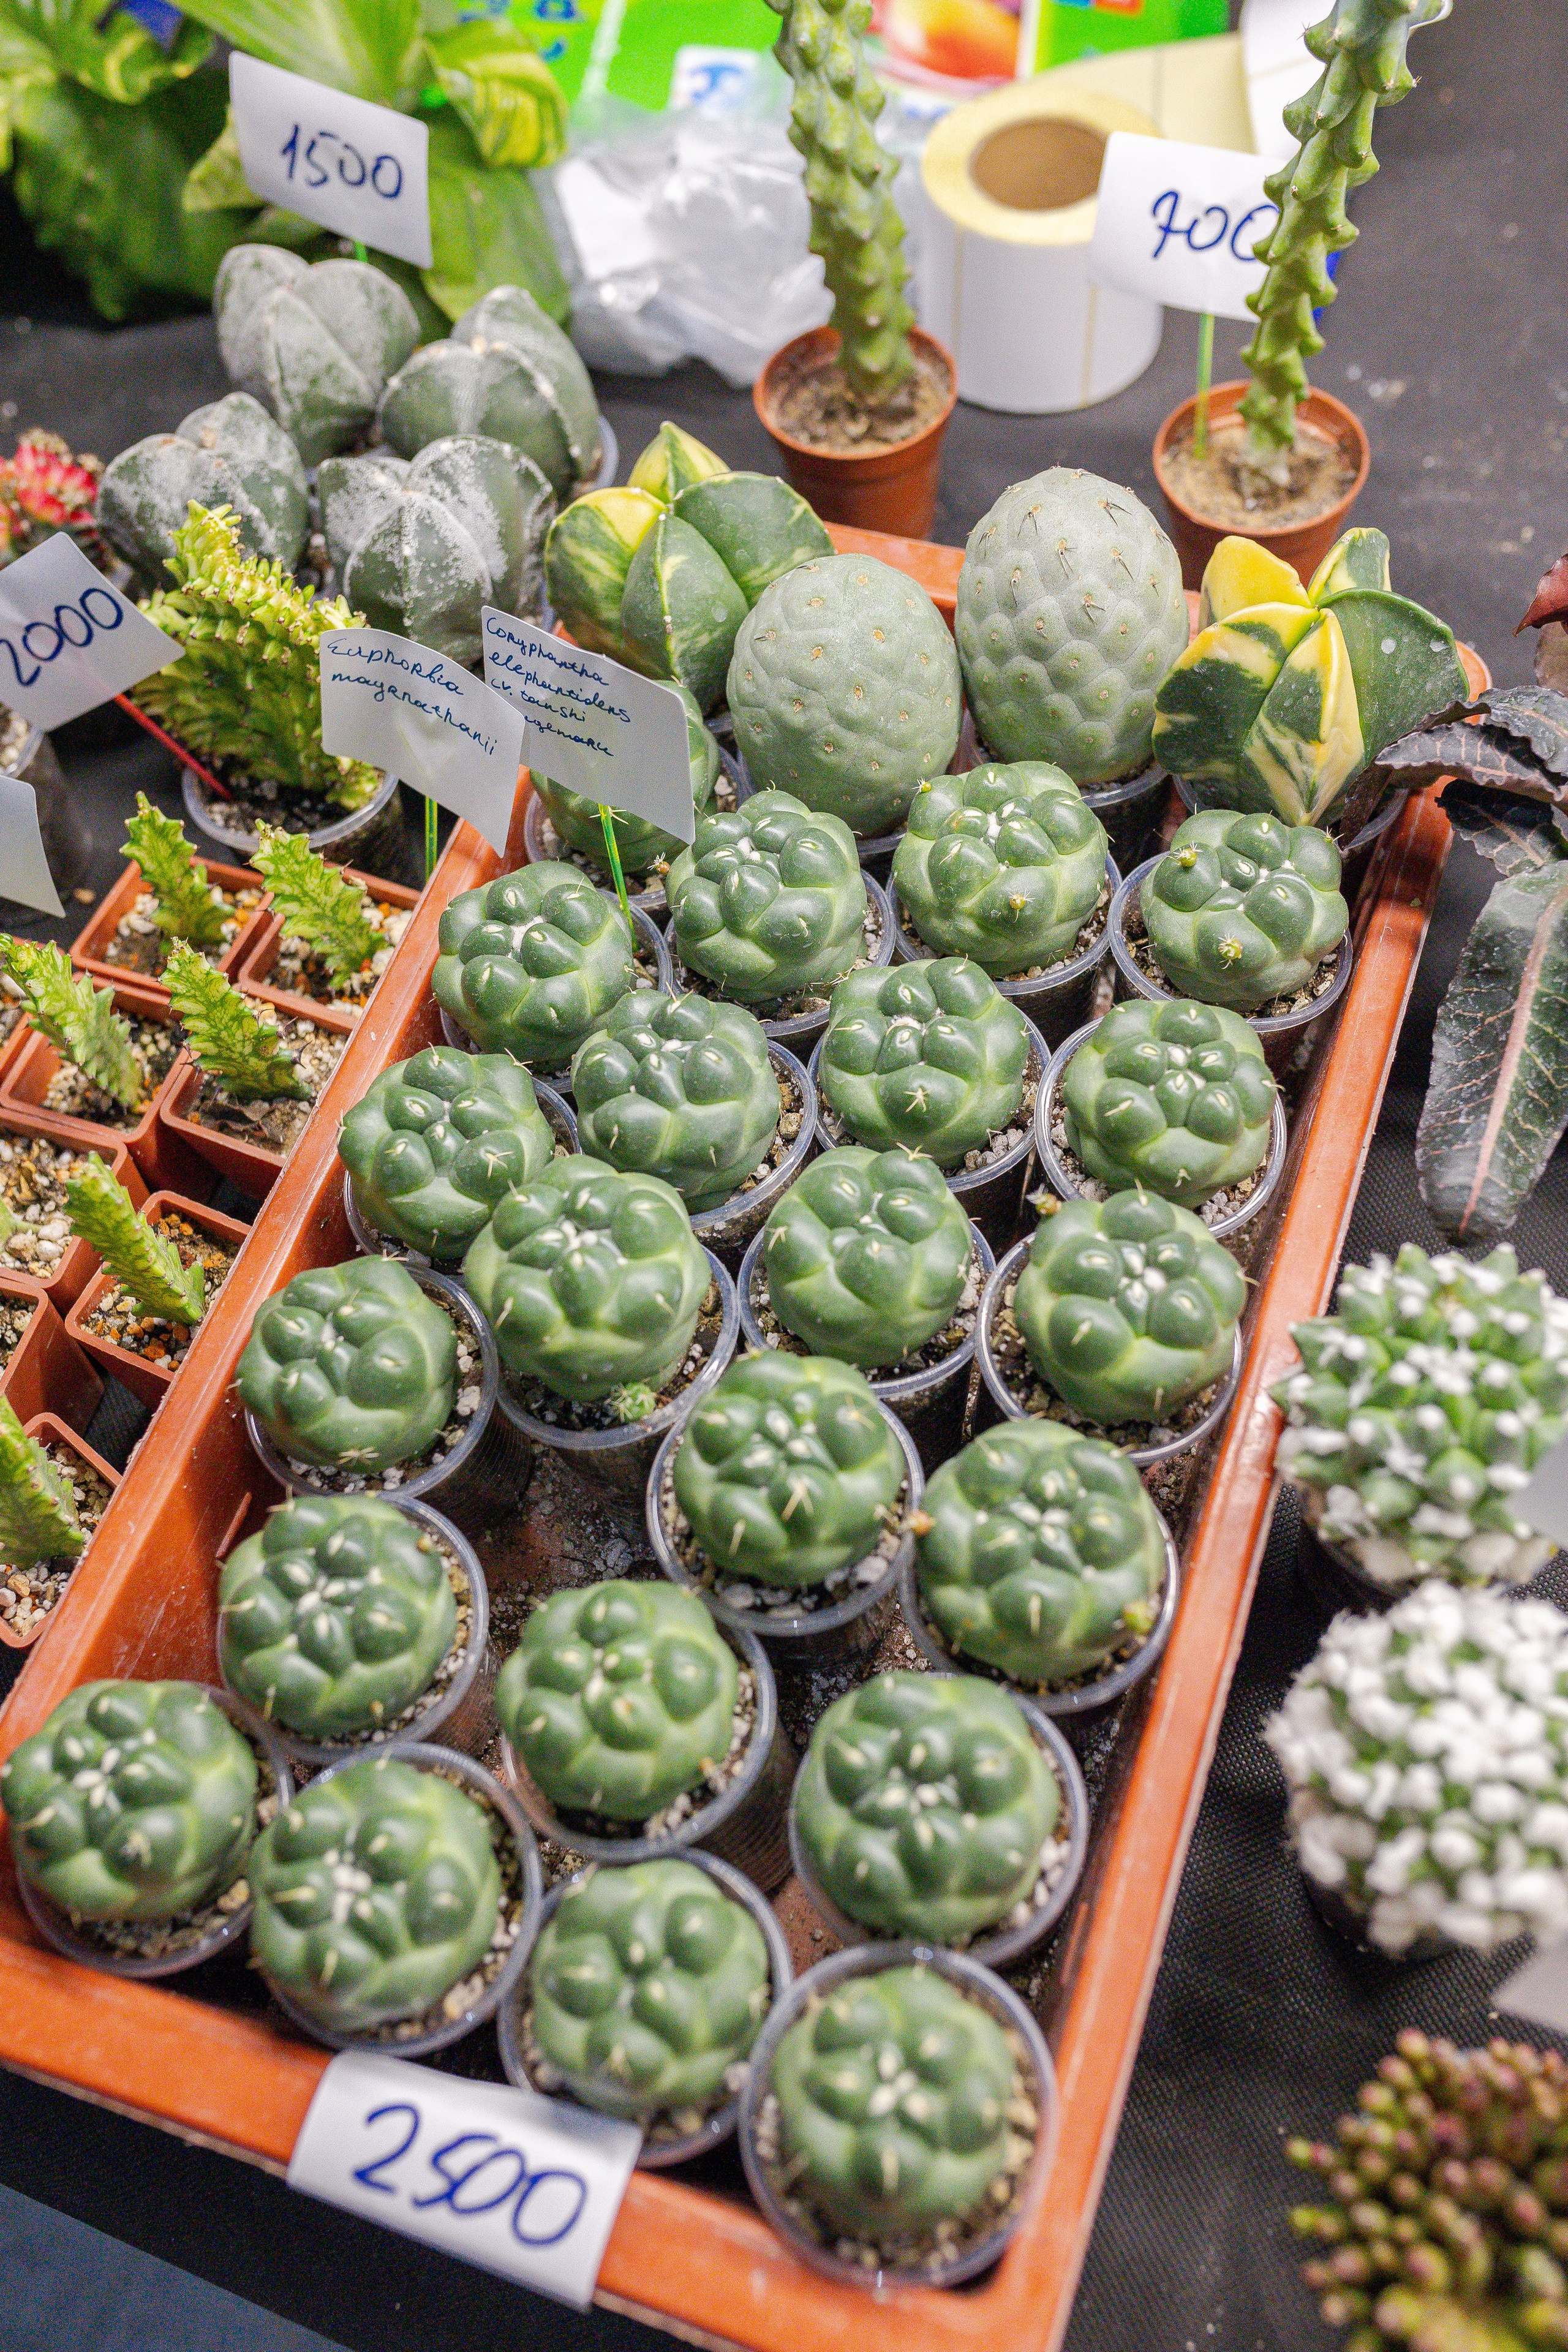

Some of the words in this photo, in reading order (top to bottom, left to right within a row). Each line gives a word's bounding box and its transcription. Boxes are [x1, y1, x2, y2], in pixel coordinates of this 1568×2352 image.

[281, 123, 403, 199] 1500
[0, 587, 124, 687] 2000
[327, 638, 464, 695] Euphorbia
[486, 616, 610, 686] Coryphantha
[488, 651, 631, 723] elephantidens
[351, 2102, 589, 2247] 2500
